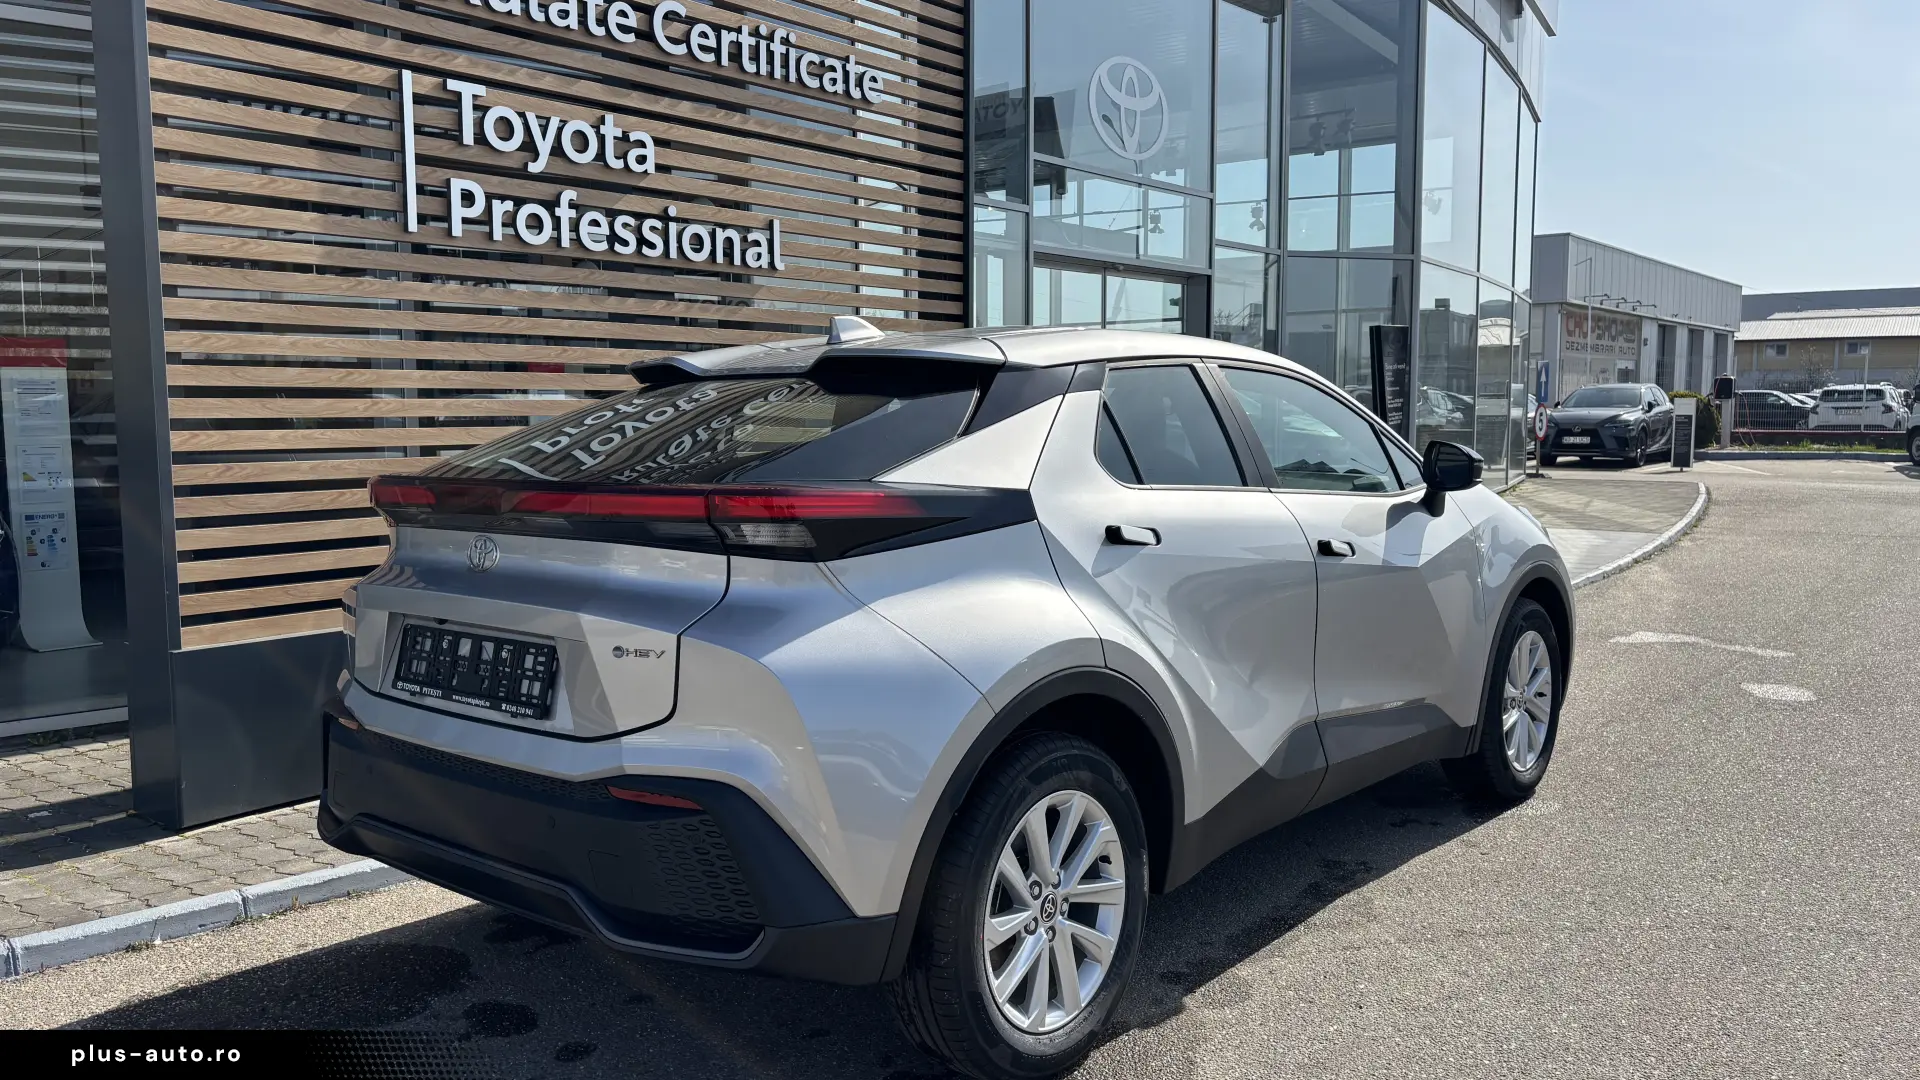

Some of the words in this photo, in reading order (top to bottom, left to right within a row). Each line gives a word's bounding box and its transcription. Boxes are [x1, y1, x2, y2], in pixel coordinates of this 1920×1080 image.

[466, 0, 637, 43] ulate
[650, 0, 884, 104] Certificate
[444, 78, 655, 174] Toyota
[448, 177, 785, 271] Professional
[1618, 346, 1636, 356] AUTO
[1538, 412, 1544, 432] 5
[624, 648, 666, 660] HEV
[403, 682, 421, 693] TOYOTA
